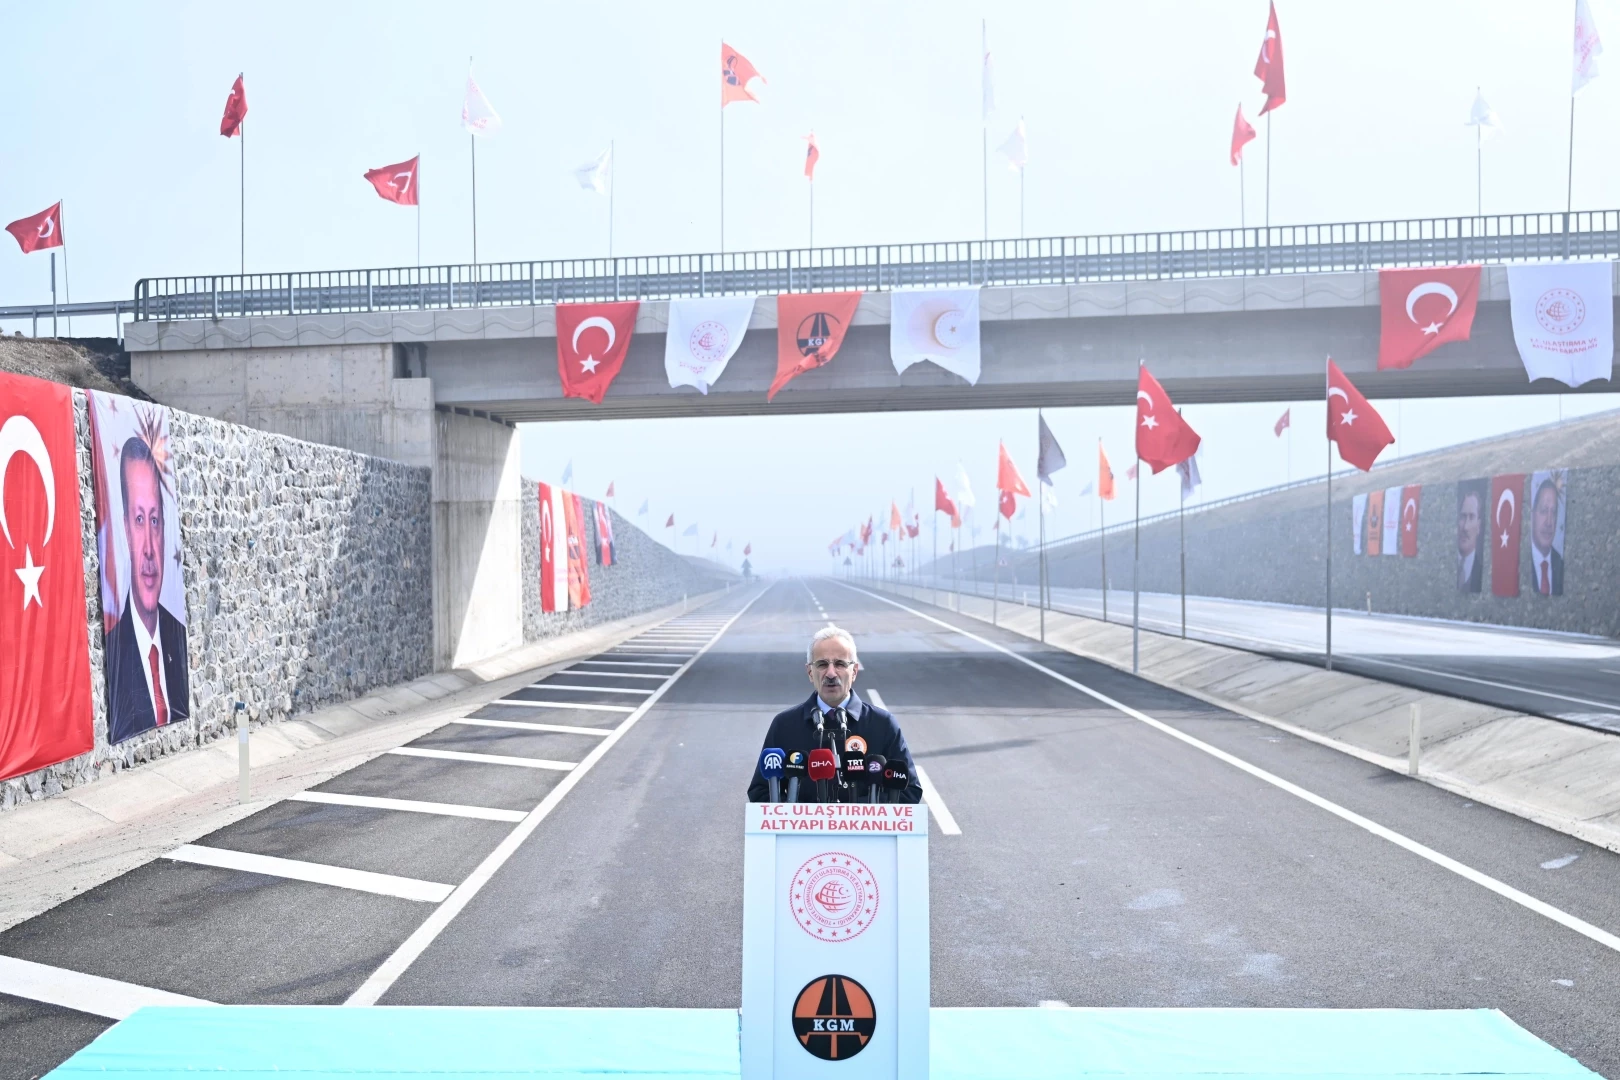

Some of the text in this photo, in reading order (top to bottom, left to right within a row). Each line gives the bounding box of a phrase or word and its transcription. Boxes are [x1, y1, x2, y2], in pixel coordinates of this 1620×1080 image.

[808, 338, 827, 346] KG
[764, 754, 783, 770] AA
[811, 760, 833, 768] DHA
[869, 763, 881, 771] 23
[760, 805, 913, 818] T.C. ULAŞTIRMA VE
[760, 818, 913, 832] ALTYAPI BAKANLIĞI
[819, 868, 850, 877] ULAŞTIRMA
[849, 874, 857, 882] VE
[813, 1018, 855, 1031] KGM
